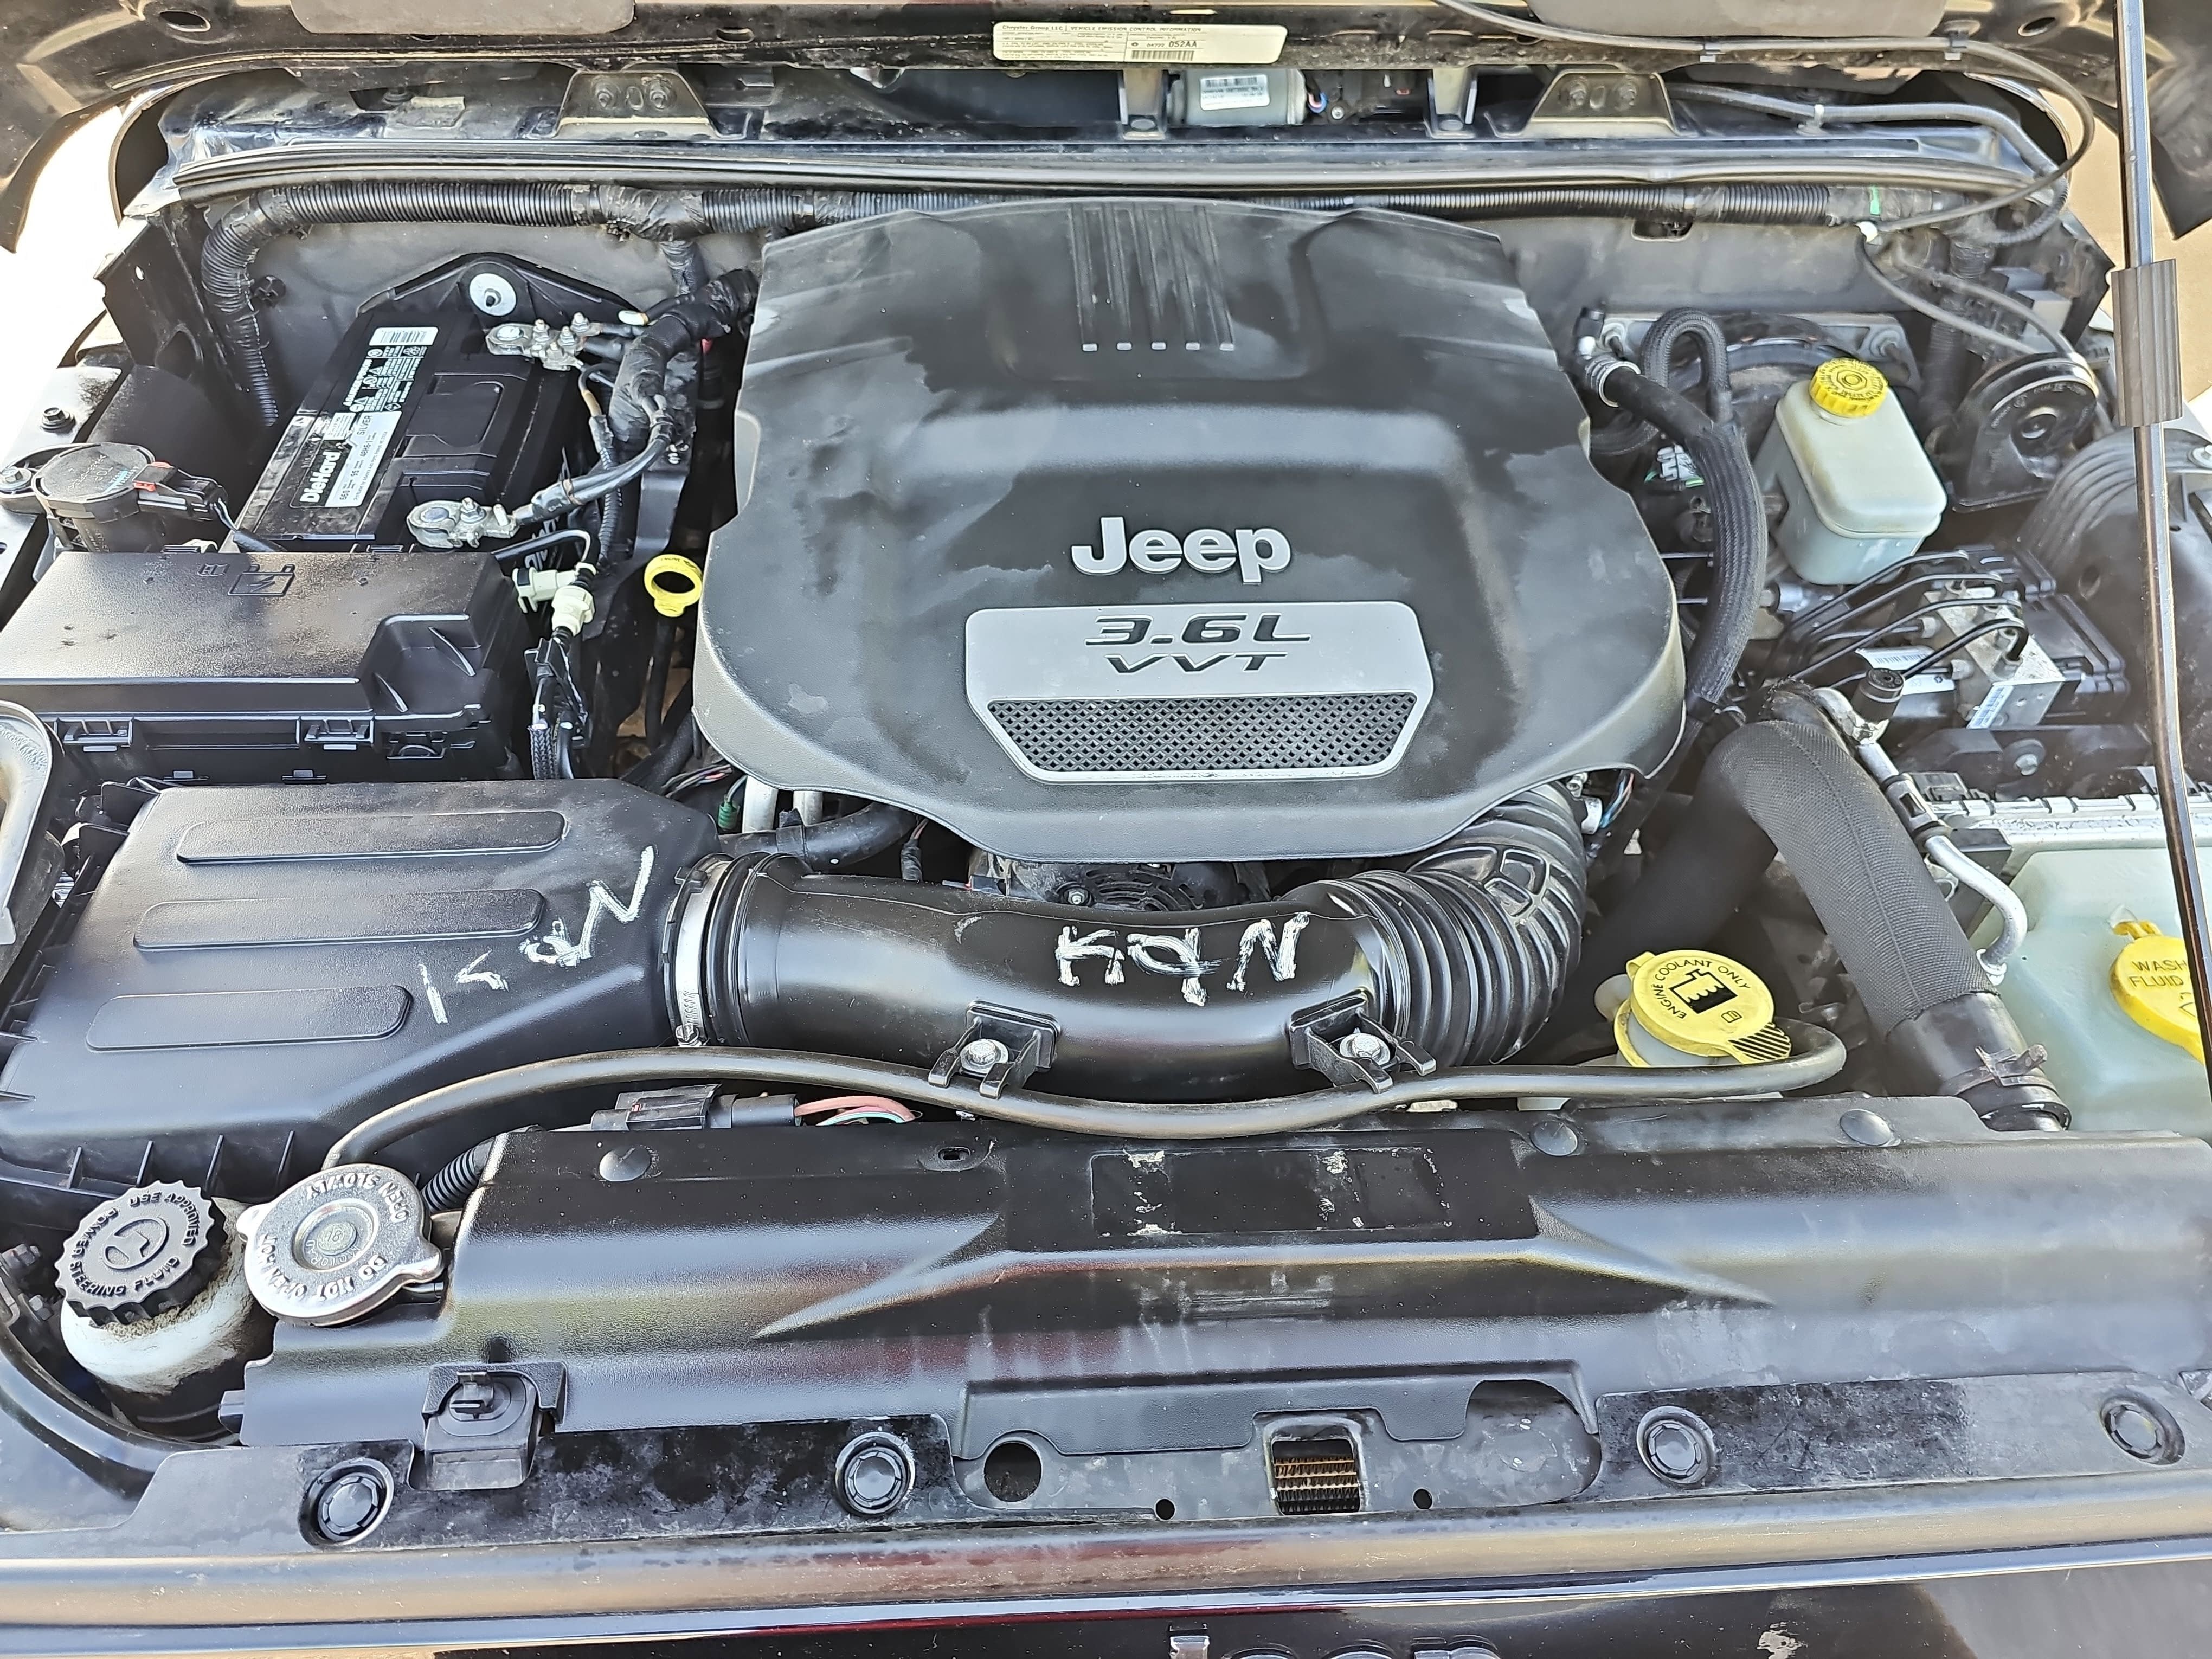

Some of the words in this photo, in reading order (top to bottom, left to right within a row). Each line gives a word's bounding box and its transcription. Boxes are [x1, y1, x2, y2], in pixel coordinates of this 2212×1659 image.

[357, 415, 372, 435] SILVER
[299, 451, 341, 503] DieHard
[1071, 516, 1291, 585] Jeep
[1084, 612, 1311, 646] 3.6L
[1104, 651, 1289, 673] VVT
[1655, 959, 1713, 981] COOLANT
[1718, 966, 1750, 989] ONLY
[2129, 975, 2184, 987] FLUID
[1653, 983, 1687, 1019] ENGINE
[129, 1192, 162, 1207] USE
[164, 1193, 200, 1247] APPROVED
[378, 1181, 409, 1223] OPEN
[71, 1208, 119, 1258] POWER
[70, 1260, 127, 1297] STEERING
[134, 1256, 180, 1291] FLUID
[268, 1266, 308, 1301] OPEN
[358, 1254, 388, 1281] DO
[311, 1276, 356, 1302] NOT
